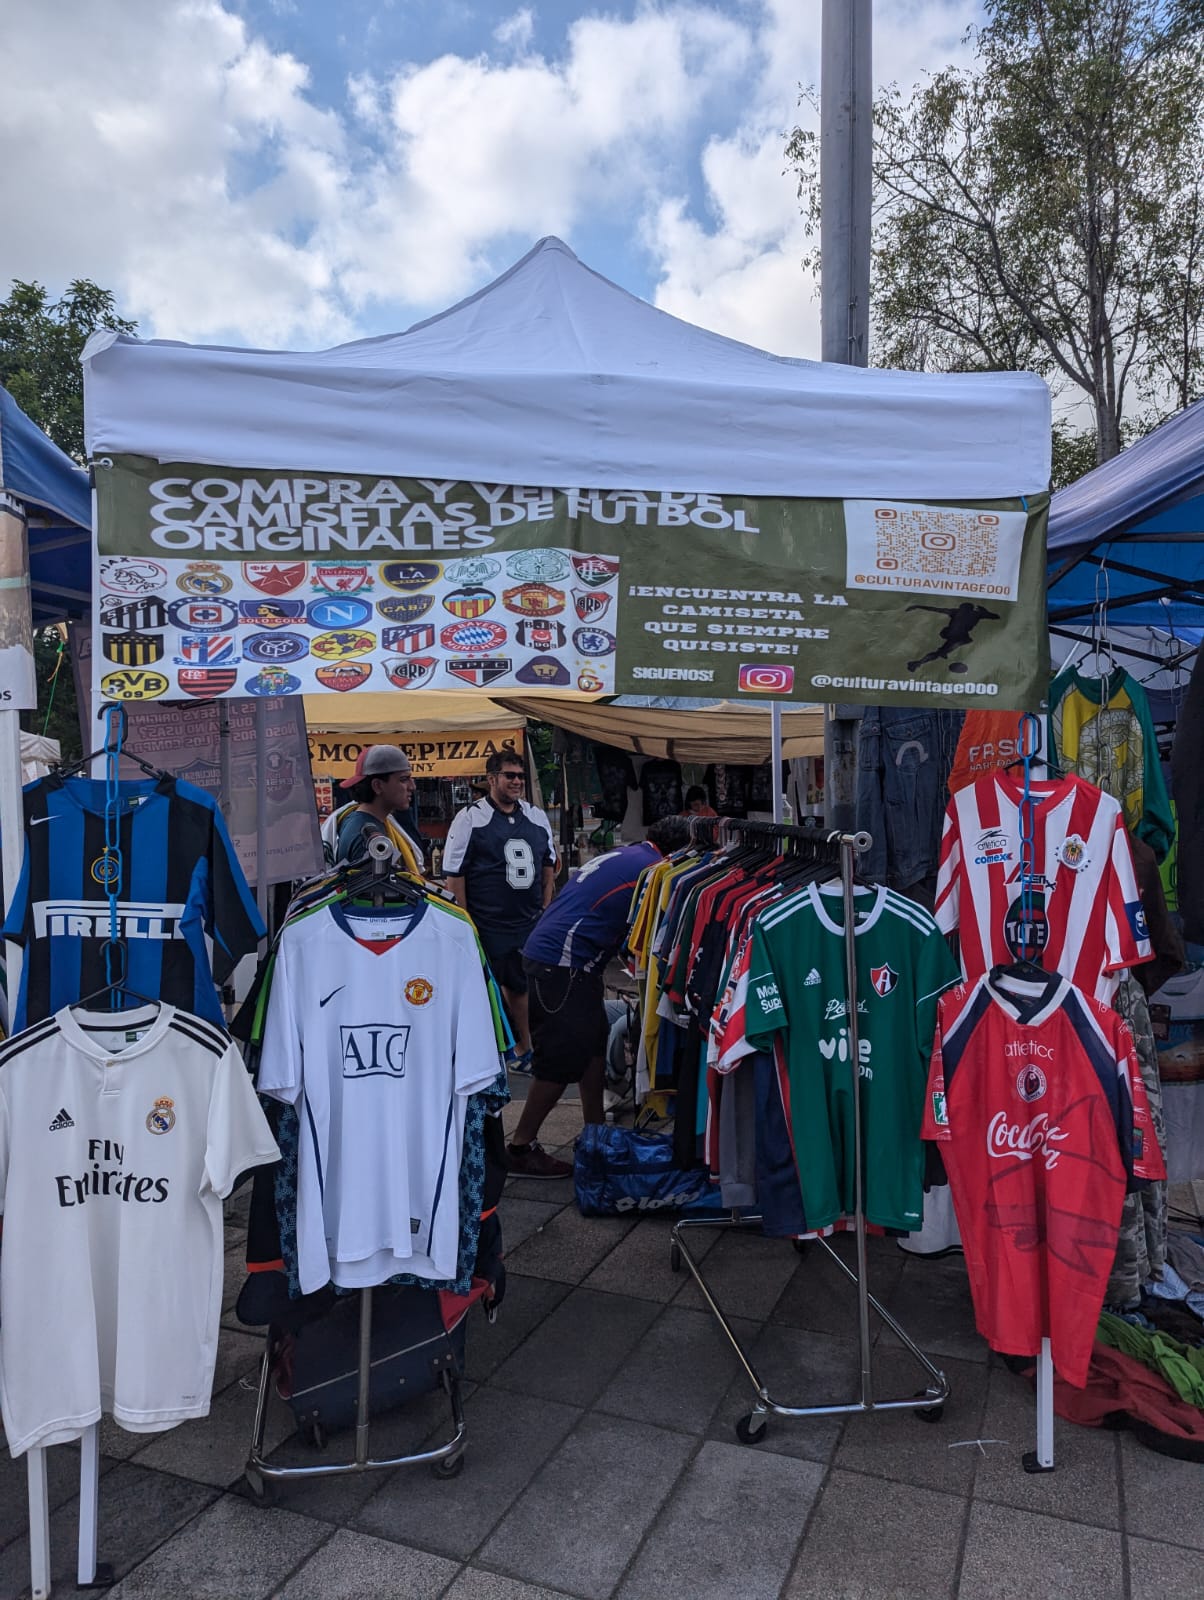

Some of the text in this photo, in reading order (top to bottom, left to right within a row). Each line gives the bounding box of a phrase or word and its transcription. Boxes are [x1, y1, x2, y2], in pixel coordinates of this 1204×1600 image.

[149, 477, 411, 503] COMPRA
[418, 479, 456, 504] Y
[149, 495, 760, 534] CAMISETAS DE FUTBOL
[150, 526, 495, 551] ORIGINALES
[399, 571, 426, 580] LA
[628, 585, 849, 606] ¡ENCUENTRA LA
[323, 605, 357, 622] N
[662, 604, 805, 621] CAMISETA
[643, 621, 830, 640] QUE SIEMPRE
[662, 639, 800, 655] QUISISTE!
[632, 666, 715, 682] SIGUENOS!
[122, 690, 145, 698] 09
[811, 674, 999, 696] @culturavintage000
[503, 838, 535, 890] 8
[48, 1120, 75, 1132] adidas
[88, 1138, 124, 1166] Fly
